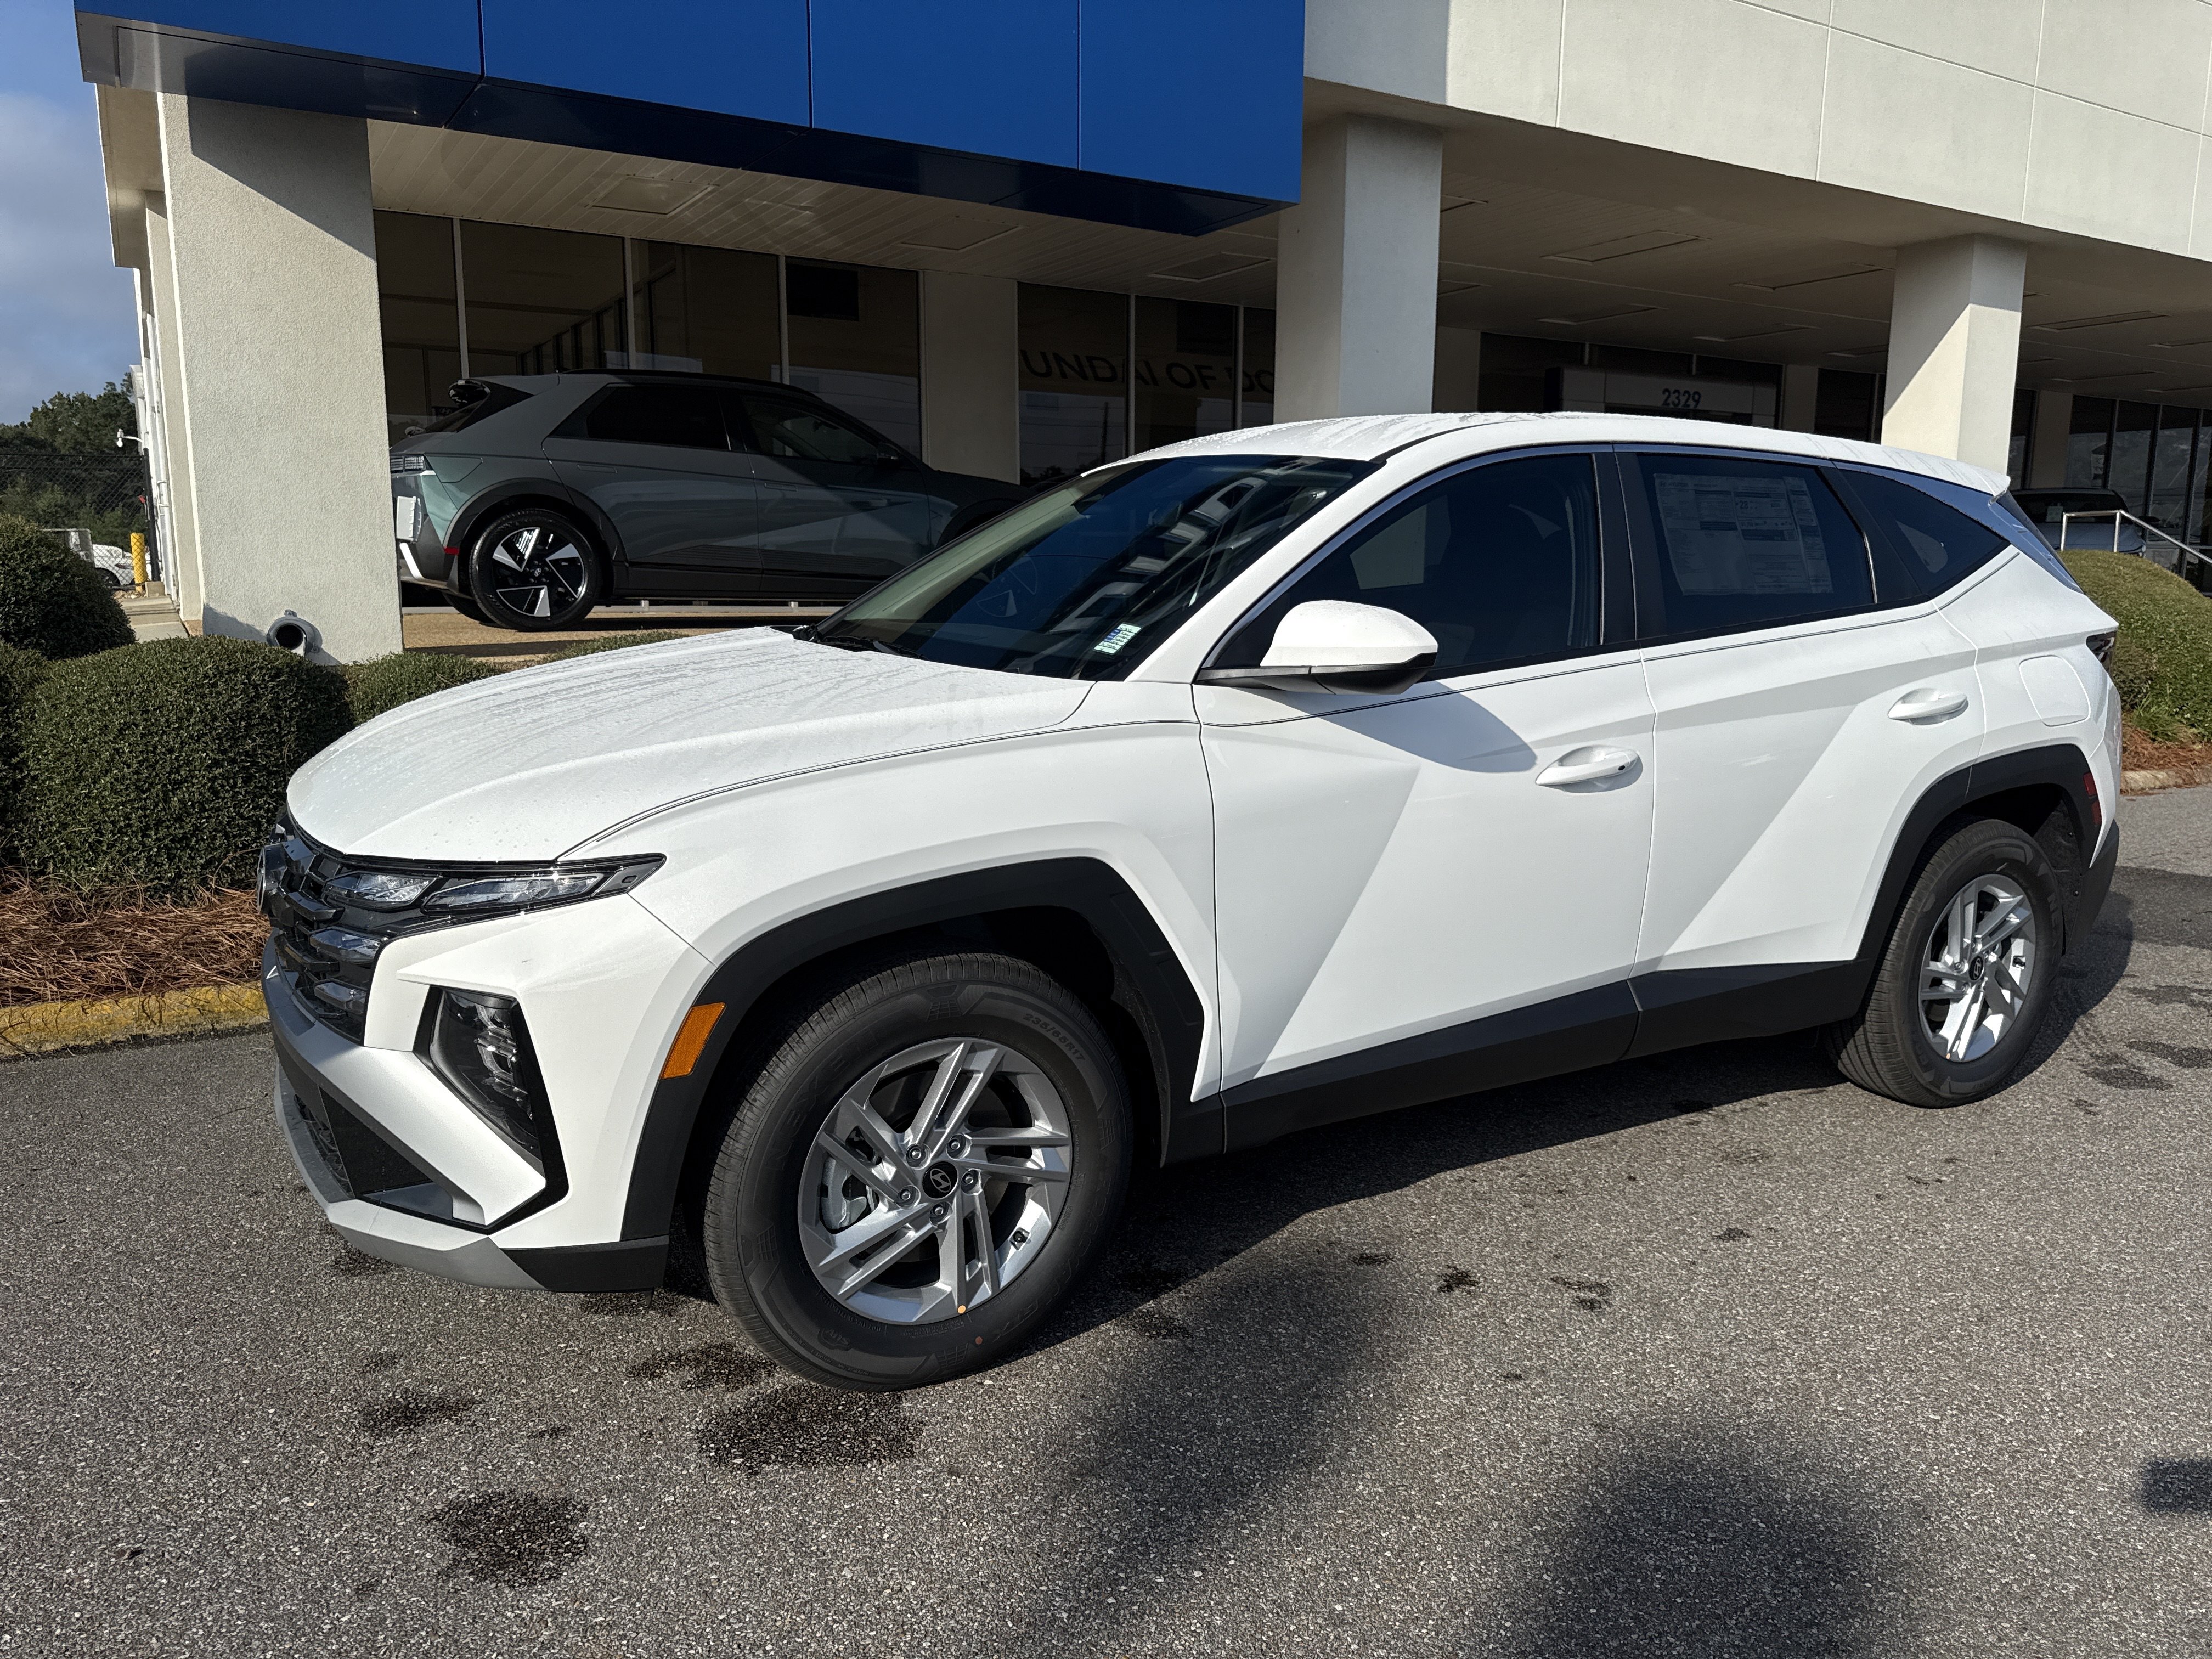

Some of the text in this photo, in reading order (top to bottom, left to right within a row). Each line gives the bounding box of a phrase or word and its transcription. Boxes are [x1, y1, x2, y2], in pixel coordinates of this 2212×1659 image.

[1166, 361, 1217, 390] OF
[1661, 388, 1701, 409] 2329
[1022, 1013, 1086, 1061] 235/65R17
